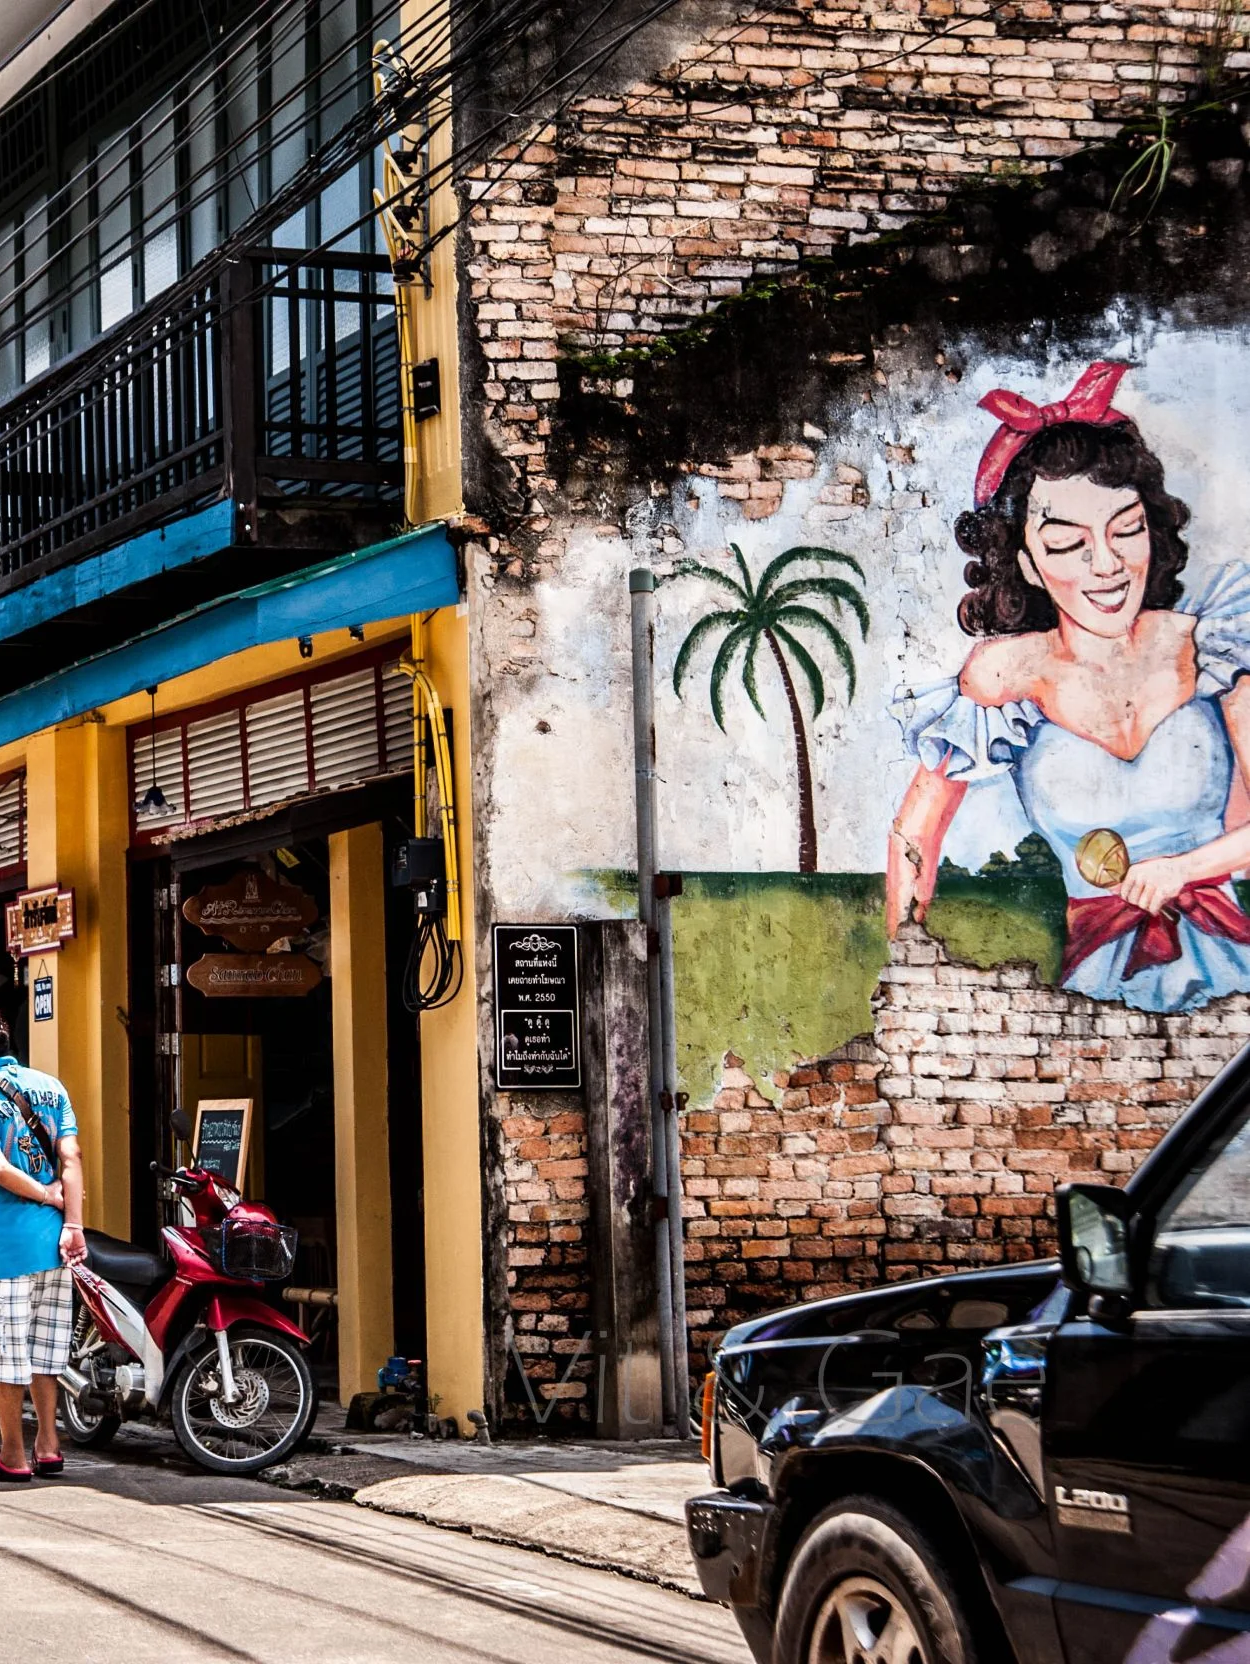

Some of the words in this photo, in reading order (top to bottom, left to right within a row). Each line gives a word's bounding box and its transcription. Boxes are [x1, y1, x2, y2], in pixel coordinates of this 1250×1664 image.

[514, 954, 558, 967] สถานที่แห่งนี้
[507, 971, 566, 985] เคยถ่ายทำโฆษณา
[518, 993, 532, 1002] พ.ศ.
[535, 993, 556, 1002] 2550
[35, 993, 52, 1016] OPEN
[524, 1033, 551, 1046] ดูเธอทำ
[1055, 1485, 1128, 1513] L200
